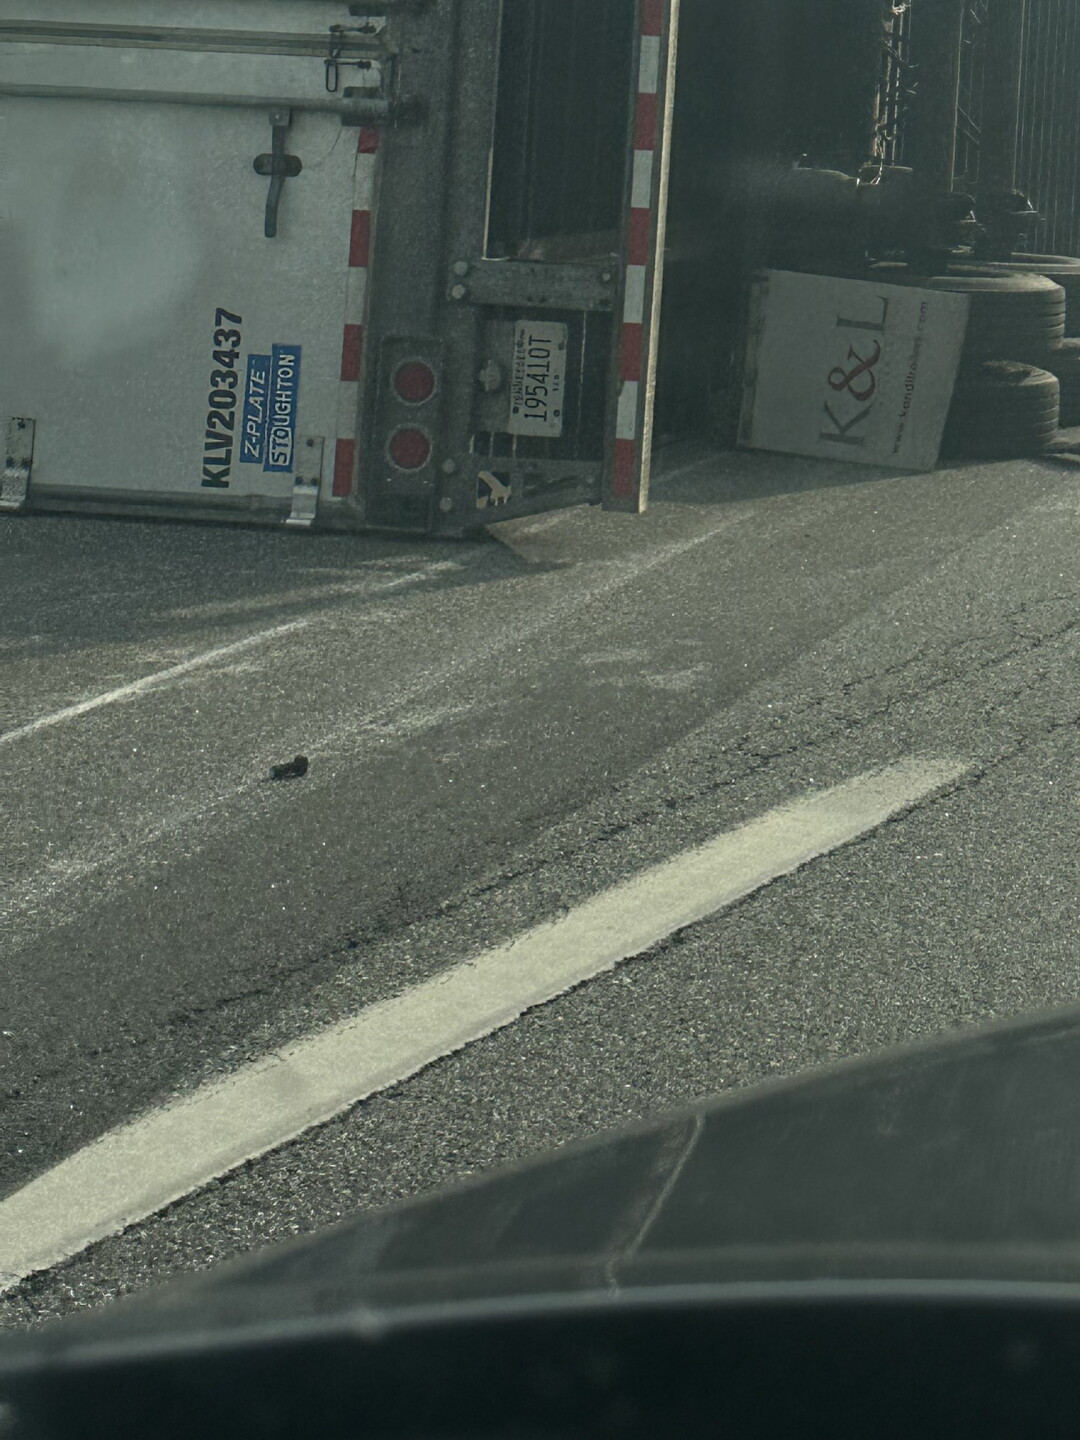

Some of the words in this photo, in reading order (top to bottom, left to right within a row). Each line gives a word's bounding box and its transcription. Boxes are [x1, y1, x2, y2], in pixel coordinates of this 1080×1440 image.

[201, 307, 242, 488] KLV203437
[244, 368, 266, 458] Z-PLATE
[269, 354, 295, 466] STOUGHTON
[524, 334, 552, 422] 195410T
[817, 295, 888, 447] K&L
